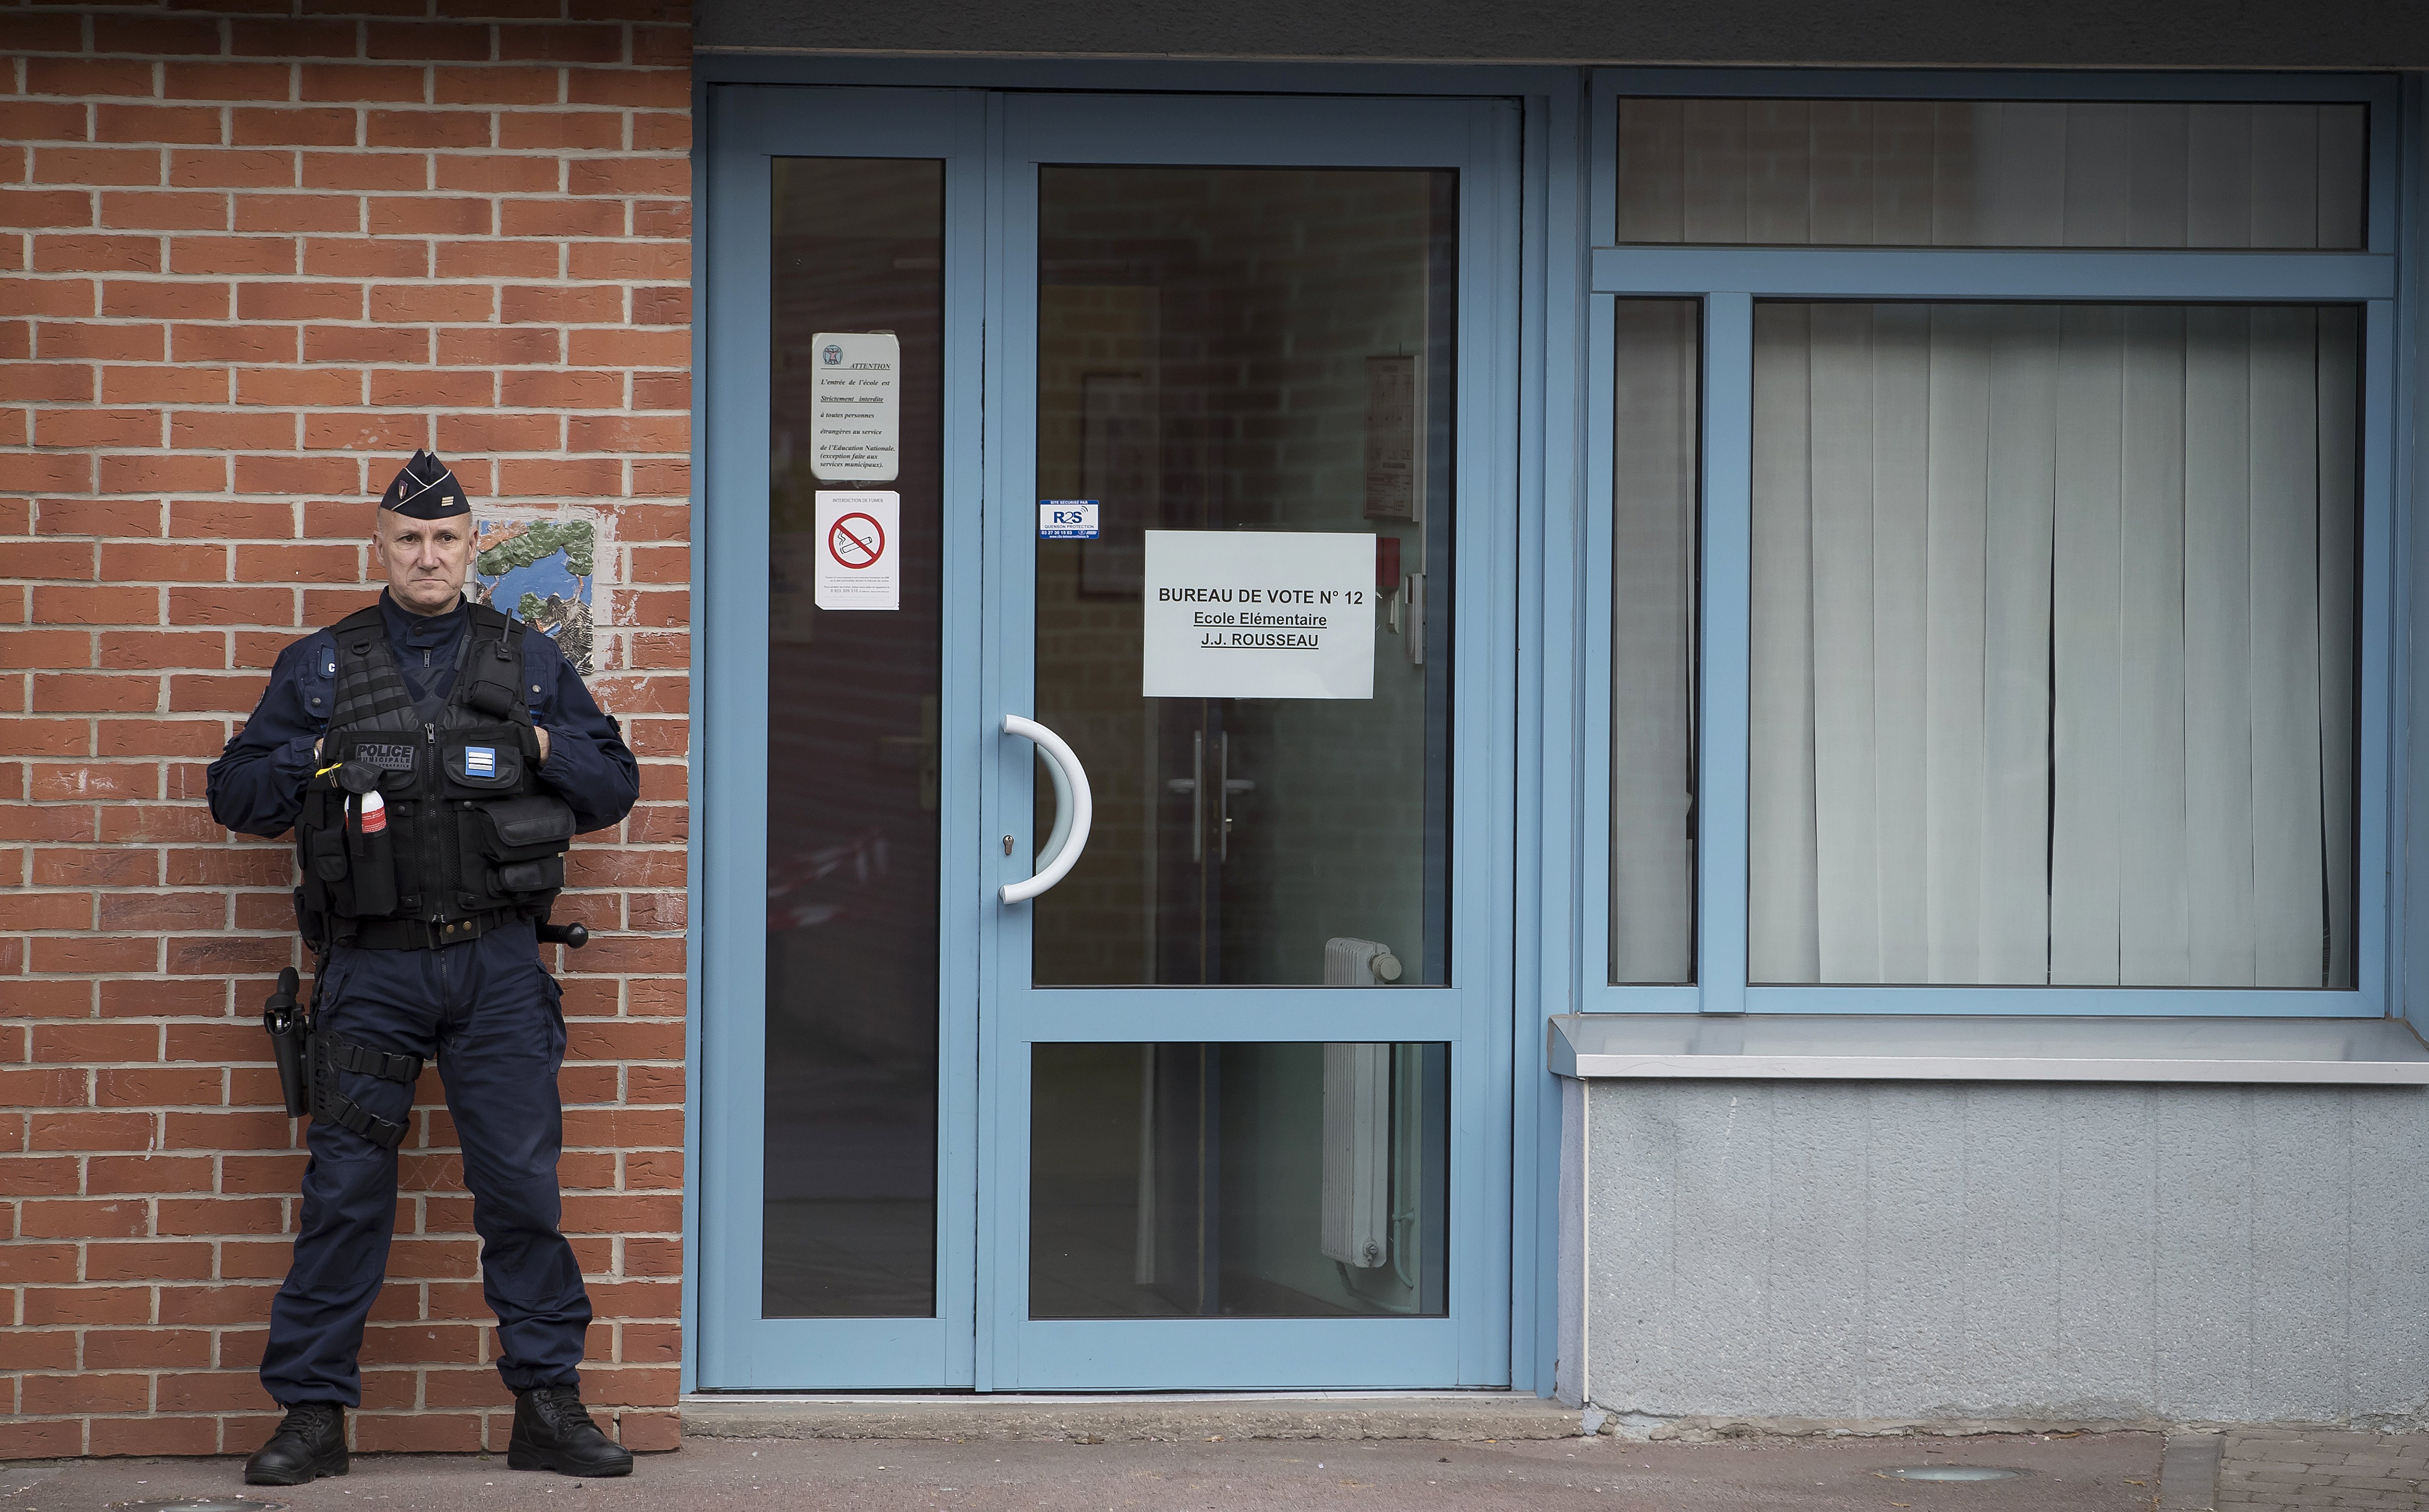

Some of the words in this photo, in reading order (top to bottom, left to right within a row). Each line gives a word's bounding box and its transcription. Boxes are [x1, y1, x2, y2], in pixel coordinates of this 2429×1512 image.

[1054, 511, 1082, 524] R2S
[1159, 588, 1232, 603] BUREAU
[1238, 589, 1262, 603] DE
[1267, 590, 1314, 604] VOTE
[1319, 590, 1338, 604] N°
[1345, 591, 1363, 605] 12
[1194, 612, 1235, 625] Ecole
[1240, 612, 1327, 626] Elémentaire
[1201, 633, 1227, 646] J.J.
[1232, 633, 1318, 646] ROUSSEAU
[357, 745, 411, 758] POLICE
